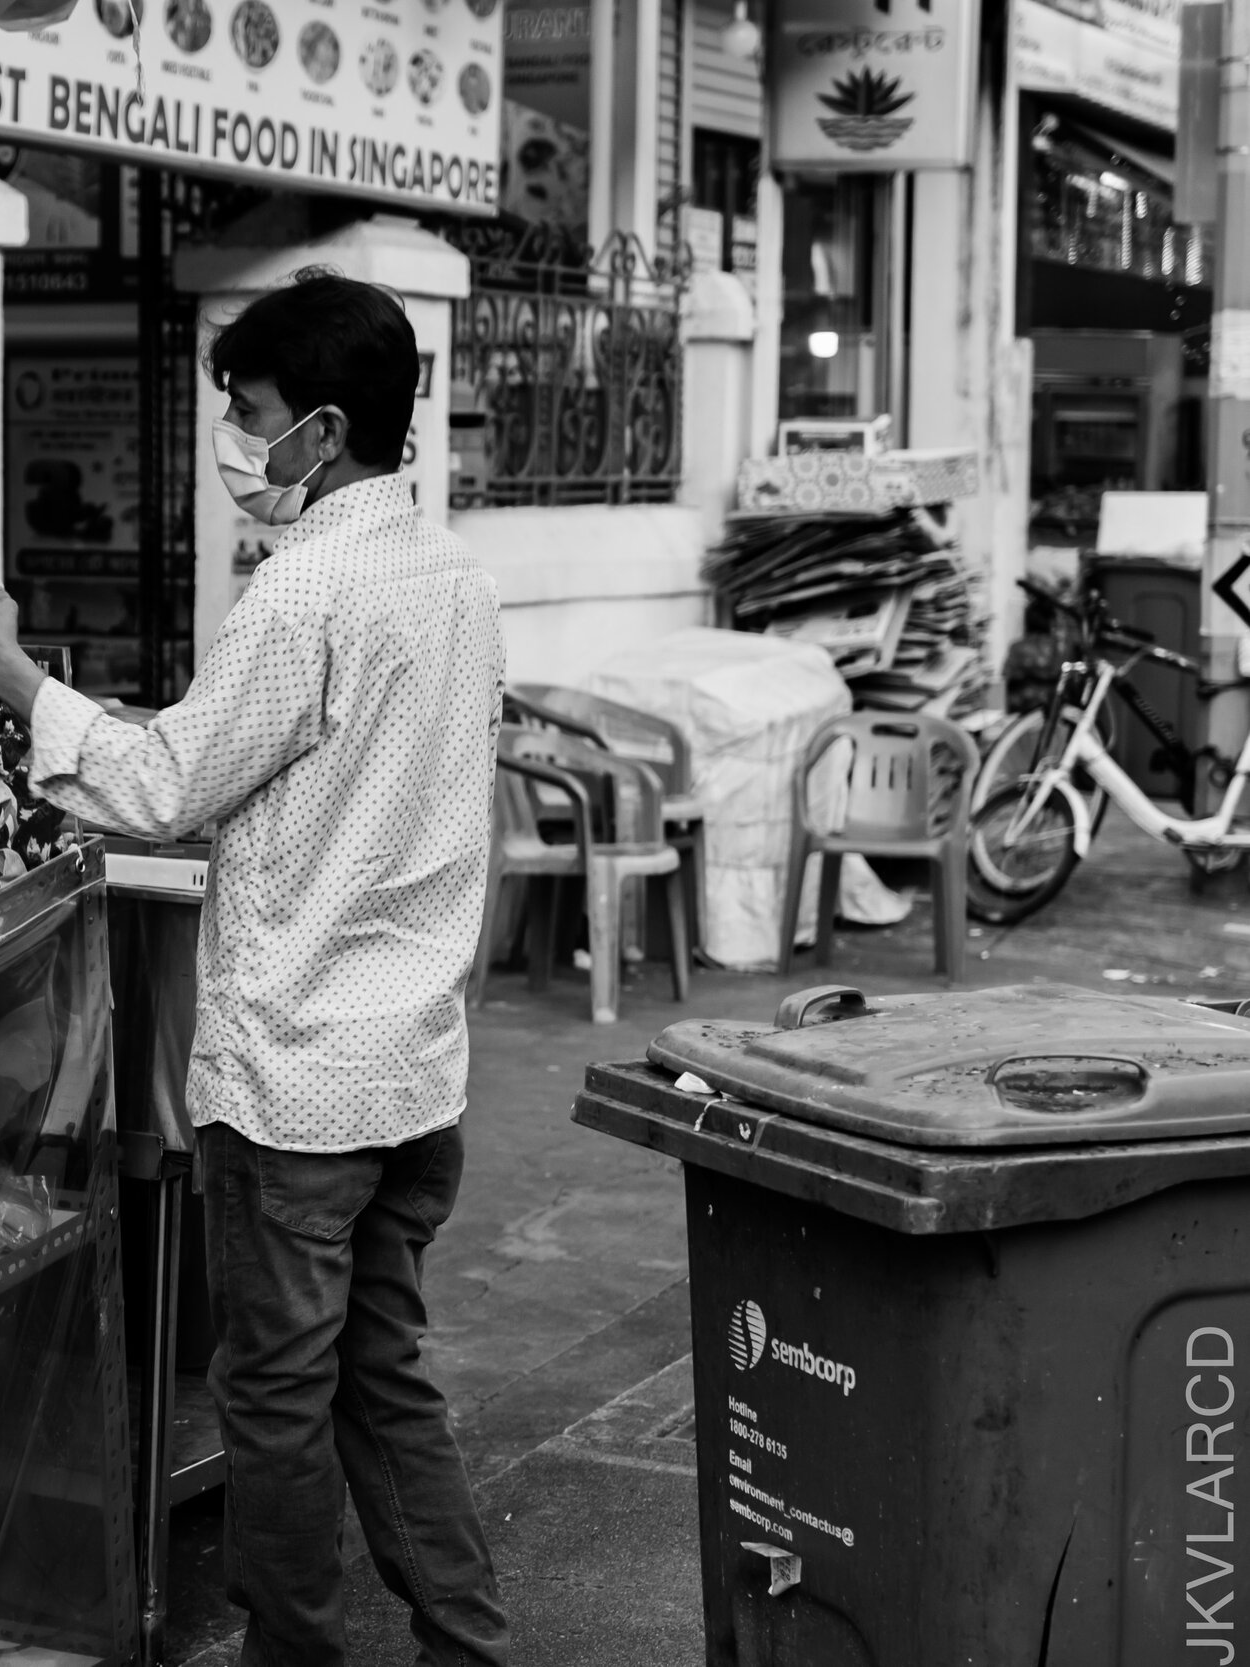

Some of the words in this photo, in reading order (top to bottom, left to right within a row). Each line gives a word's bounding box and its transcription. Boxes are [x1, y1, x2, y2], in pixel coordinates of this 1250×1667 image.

[49, 75, 200, 157] BENGALI
[212, 108, 299, 171] FOOD
[309, 127, 340, 179] IN
[350, 139, 497, 204] SINGAPORE
[771, 1337, 856, 1396] sembcorp
[729, 1395, 758, 1423] Hotline
[729, 1417, 765, 1448] 1800-278
[766, 1434, 788, 1460] 6135
[729, 1449, 752, 1474] Email
[729, 1473, 855, 1547] environment_contactus@
[730, 1499, 793, 1542] sembcorp.com
